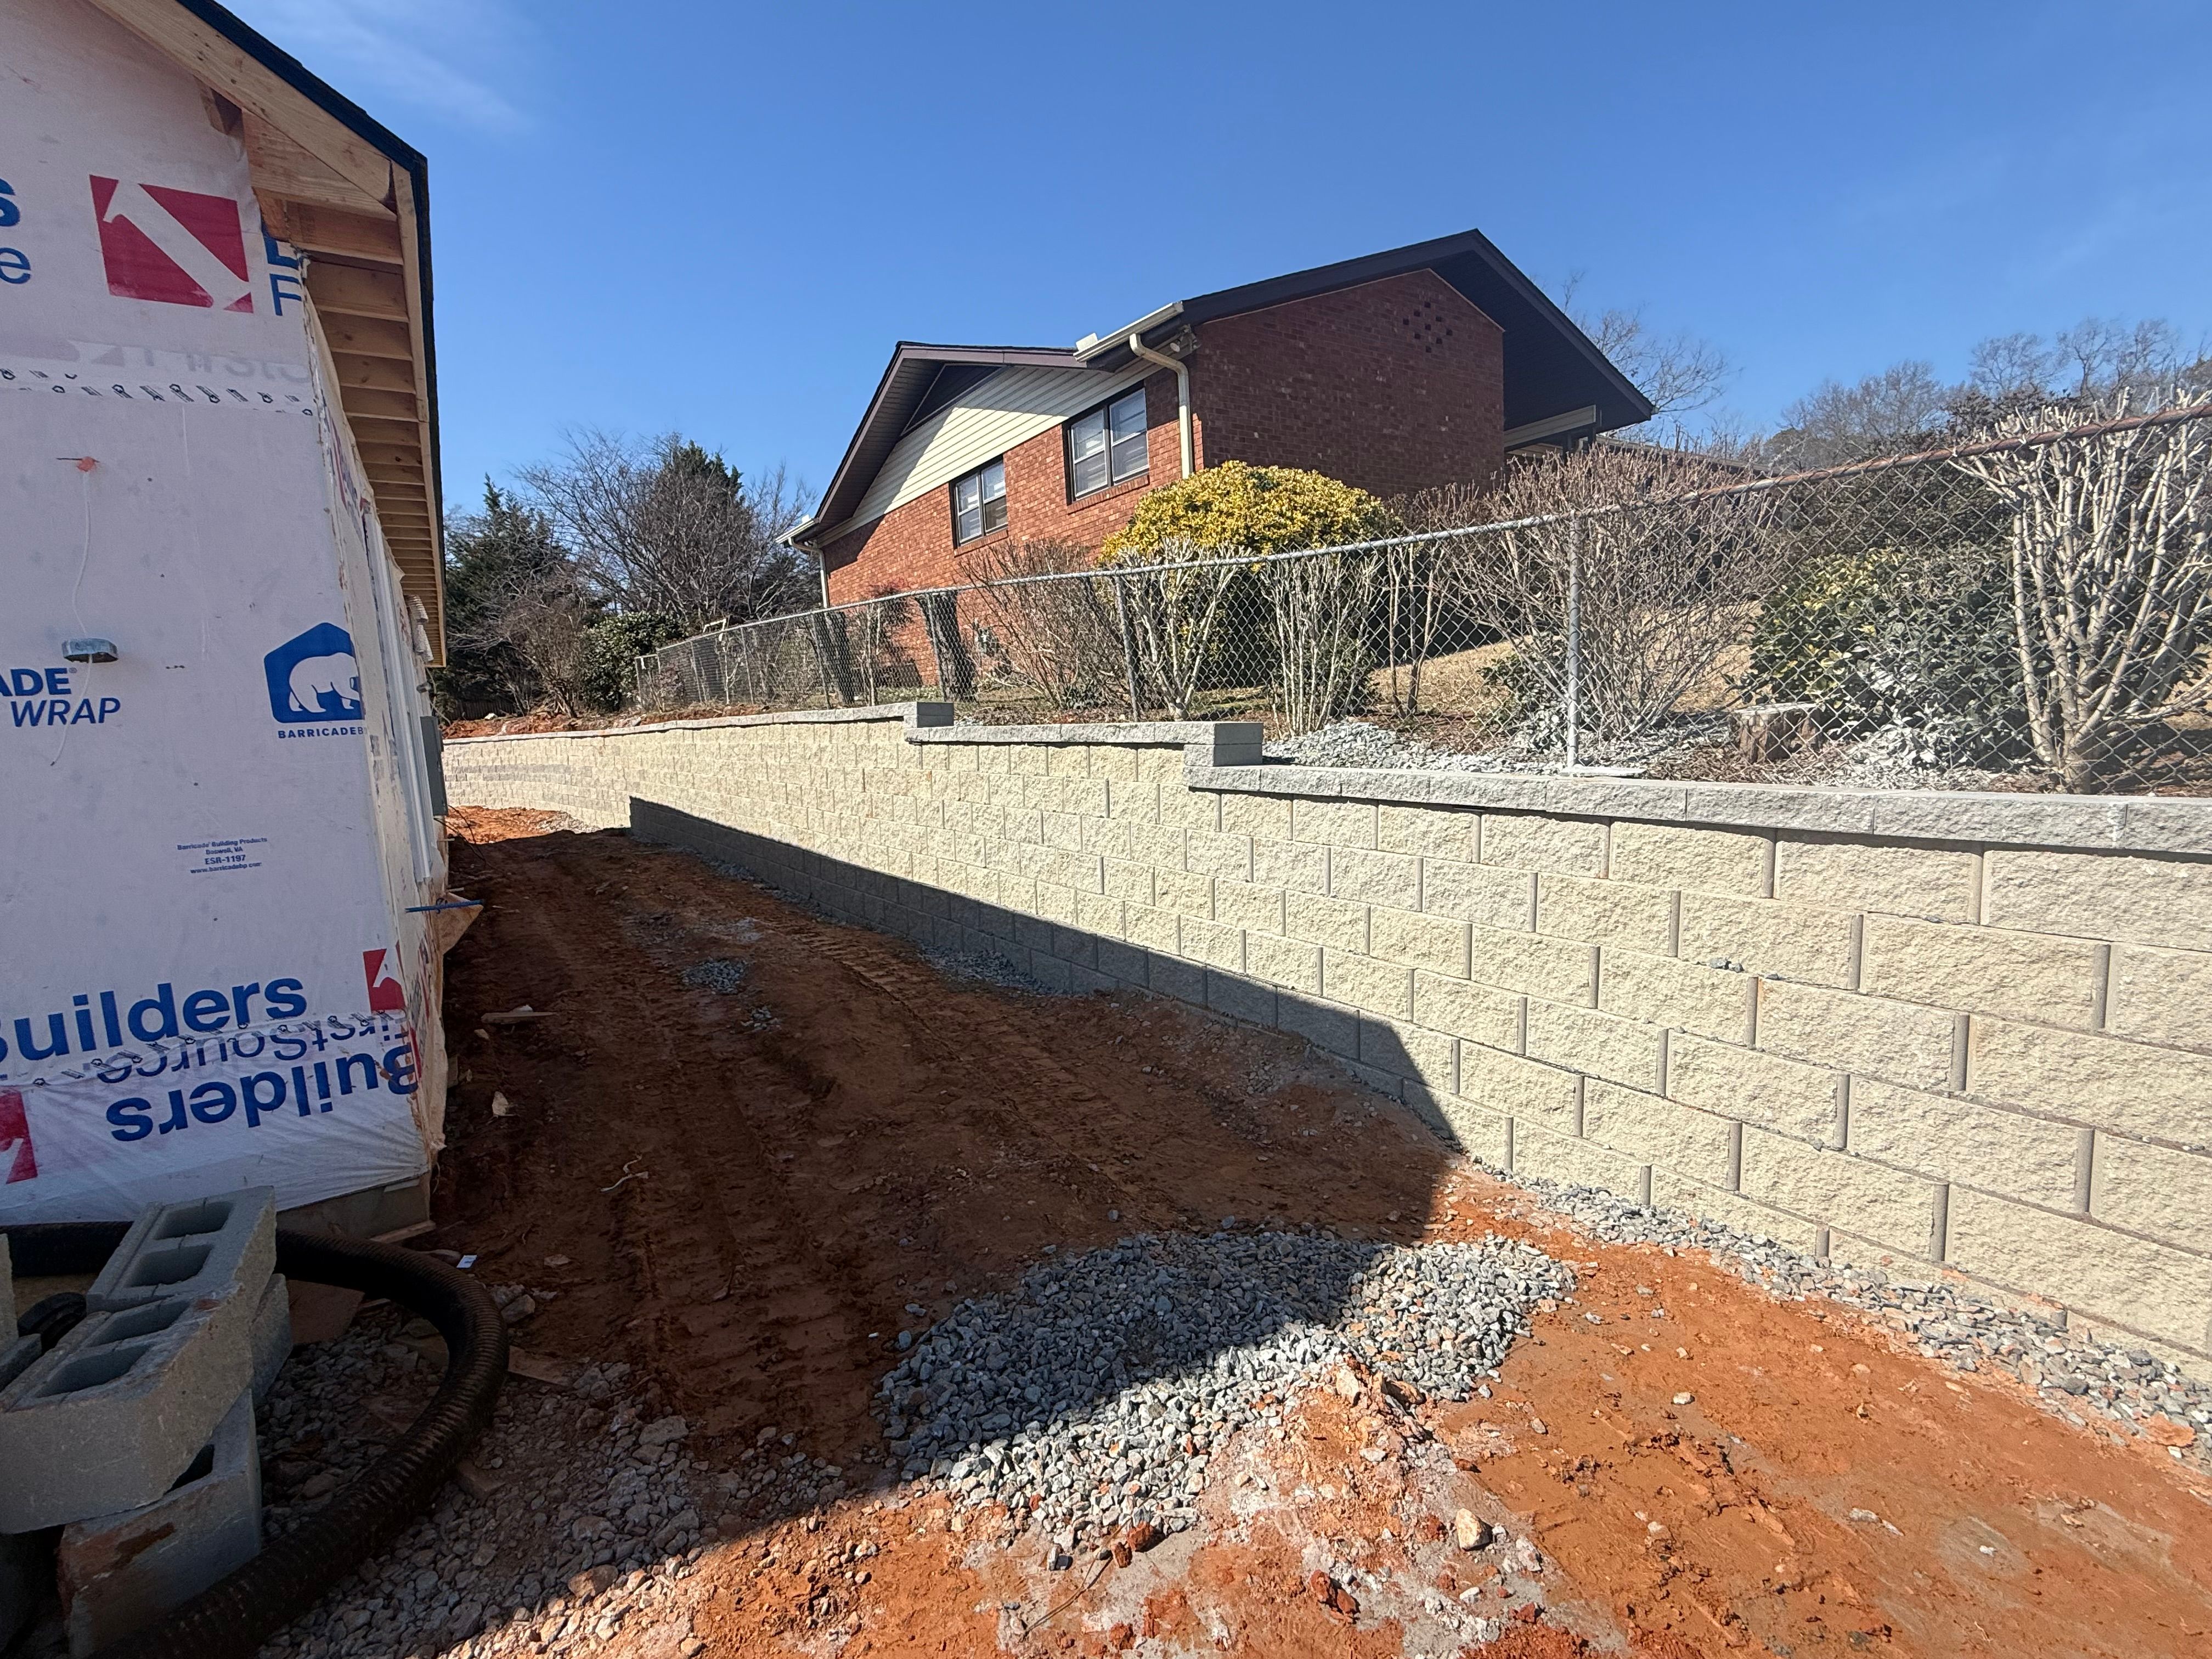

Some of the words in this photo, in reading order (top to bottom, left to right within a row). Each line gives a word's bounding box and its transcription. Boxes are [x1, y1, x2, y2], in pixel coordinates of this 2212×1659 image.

[10, 697, 121, 727] WRAP
[205, 854, 246, 865] ESR-1197
[0, 977, 307, 1063] uilders
